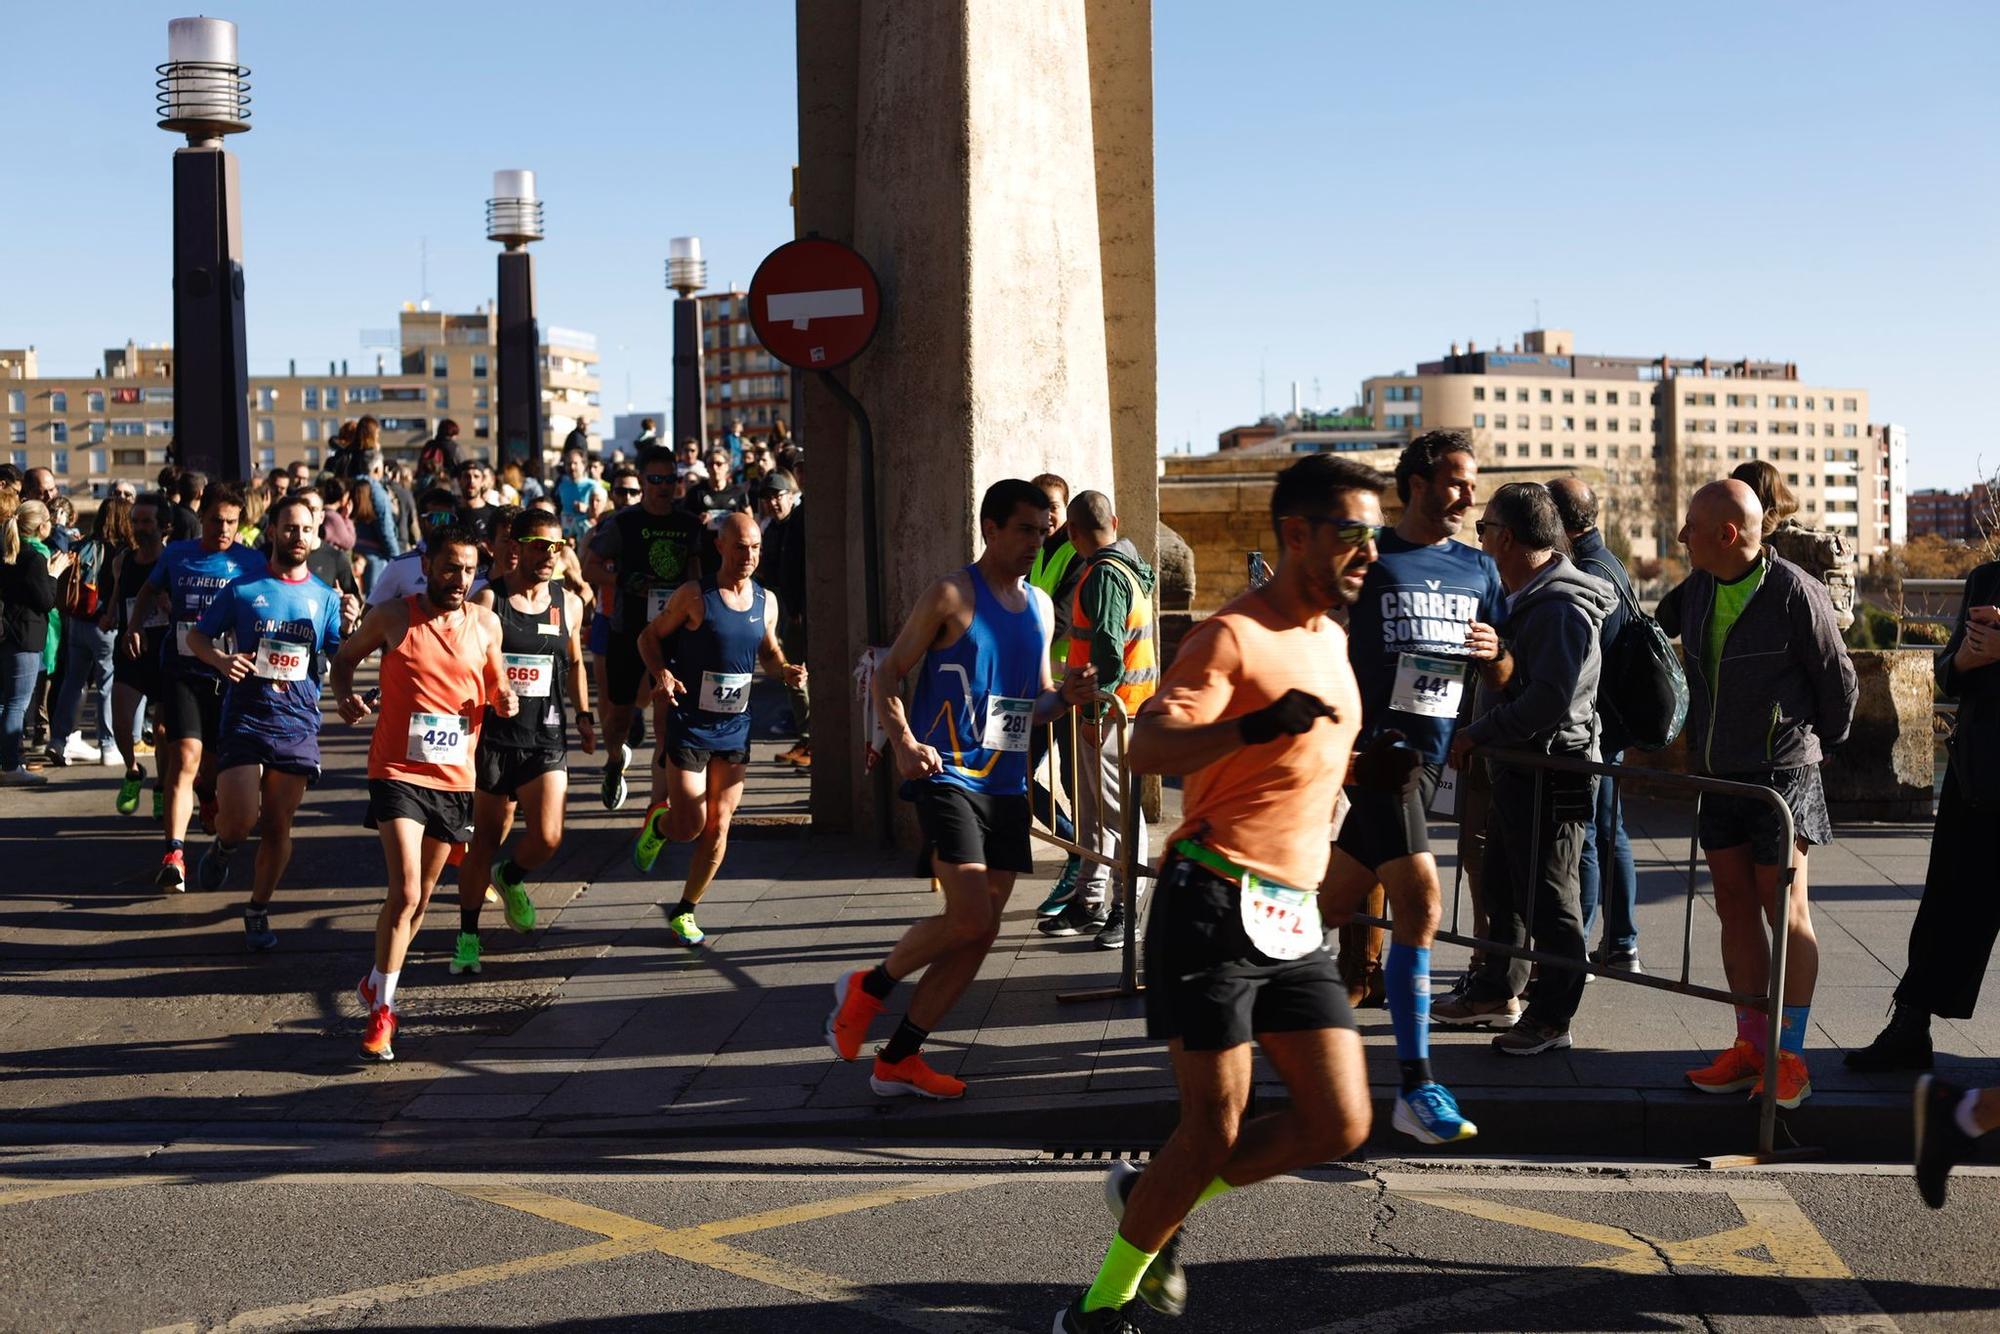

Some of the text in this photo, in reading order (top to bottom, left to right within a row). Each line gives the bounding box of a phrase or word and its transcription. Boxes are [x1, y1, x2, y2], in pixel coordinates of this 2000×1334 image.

[268, 652, 299, 667] 696
[506, 666, 540, 681] 669
[713, 686, 741, 700] 474
[1413, 675, 1450, 697] 441
[1002, 714, 1027, 733] 281
[424, 730, 458, 747] 420
